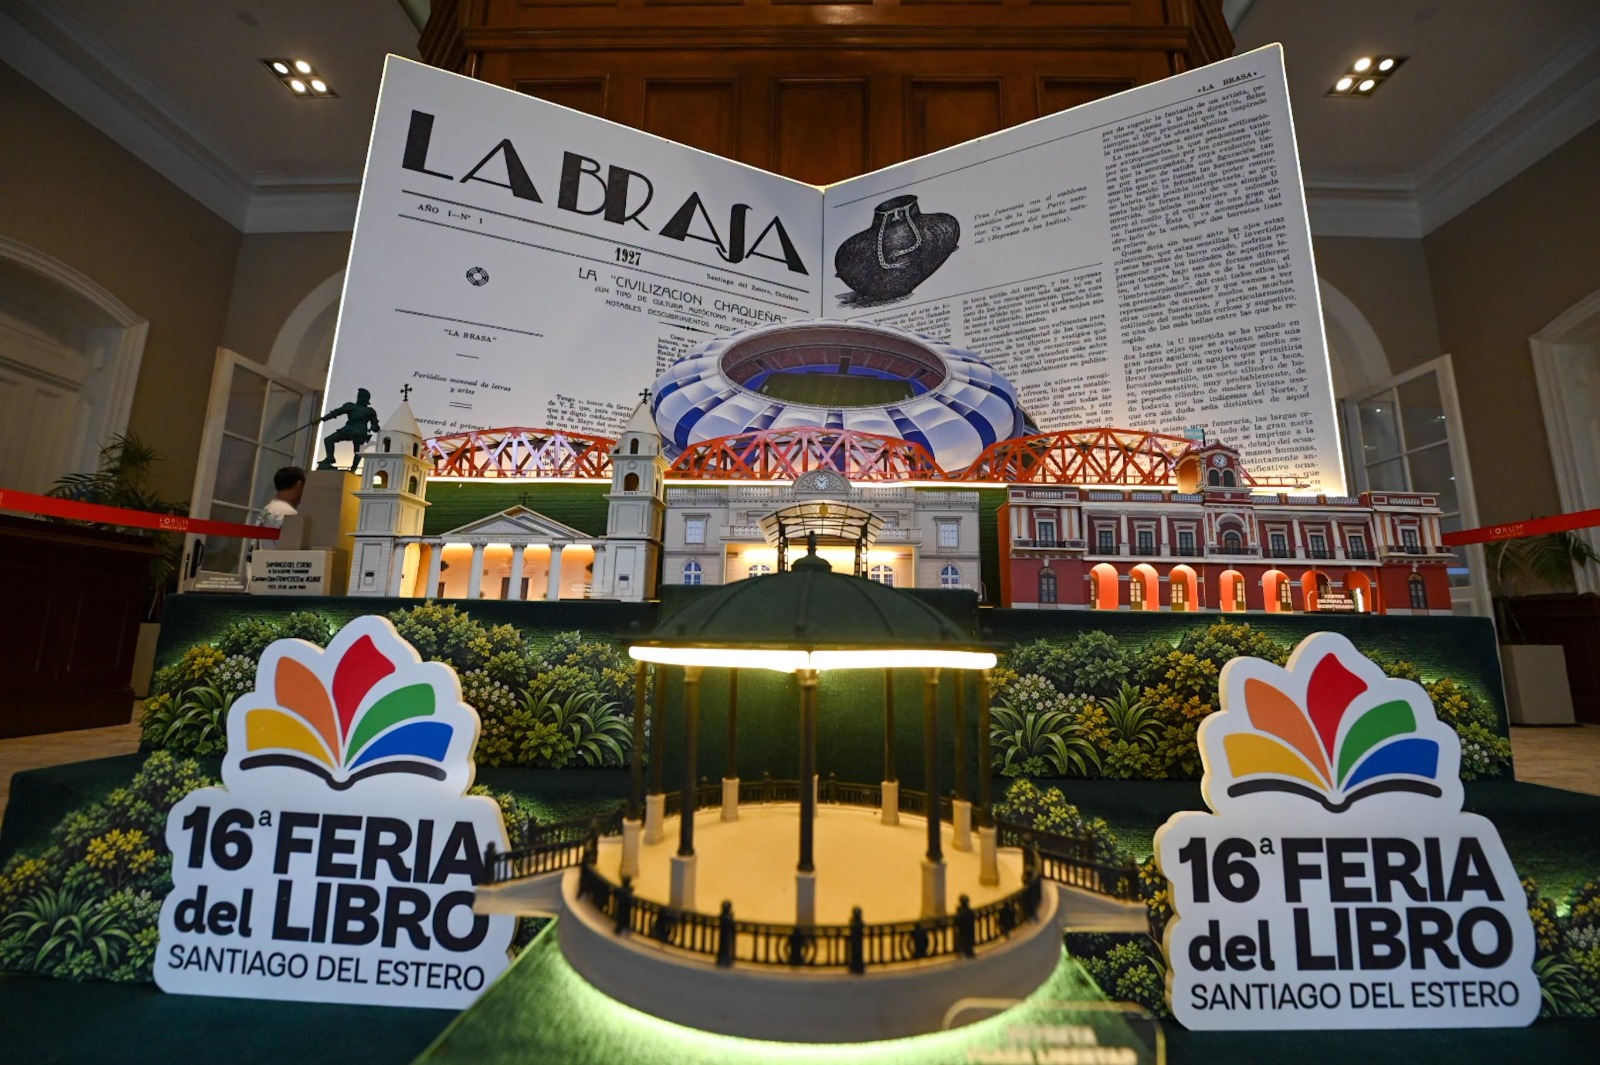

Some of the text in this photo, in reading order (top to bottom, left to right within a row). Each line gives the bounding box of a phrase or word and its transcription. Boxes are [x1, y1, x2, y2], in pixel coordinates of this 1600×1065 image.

[402, 110, 543, 204] LA
[578, 266, 597, 282] LA
[614, 246, 642, 266] 1927
[605, 299, 642, 313] NOTABLES
[647, 308, 710, 327] DESCUBRIMIENTOS
[615, 289, 632, 299] TIPO
[637, 294, 647, 303] DE
[652, 298, 684, 310] CULTURA
[449, 378, 478, 387] mensual
[480, 380, 489, 388] de
[491, 382, 511, 392] letras
[273, 811, 487, 886] FERIA
[1281, 837, 1505, 903] FERIA
[174, 879, 490, 953] del LIBRO
[1188, 906, 1514, 972] del LIBRO
[168, 944, 486, 992] SANTIAGO DEL ESTERO
[1191, 980, 1520, 1011] SANTIAGO DEL ESTERO
